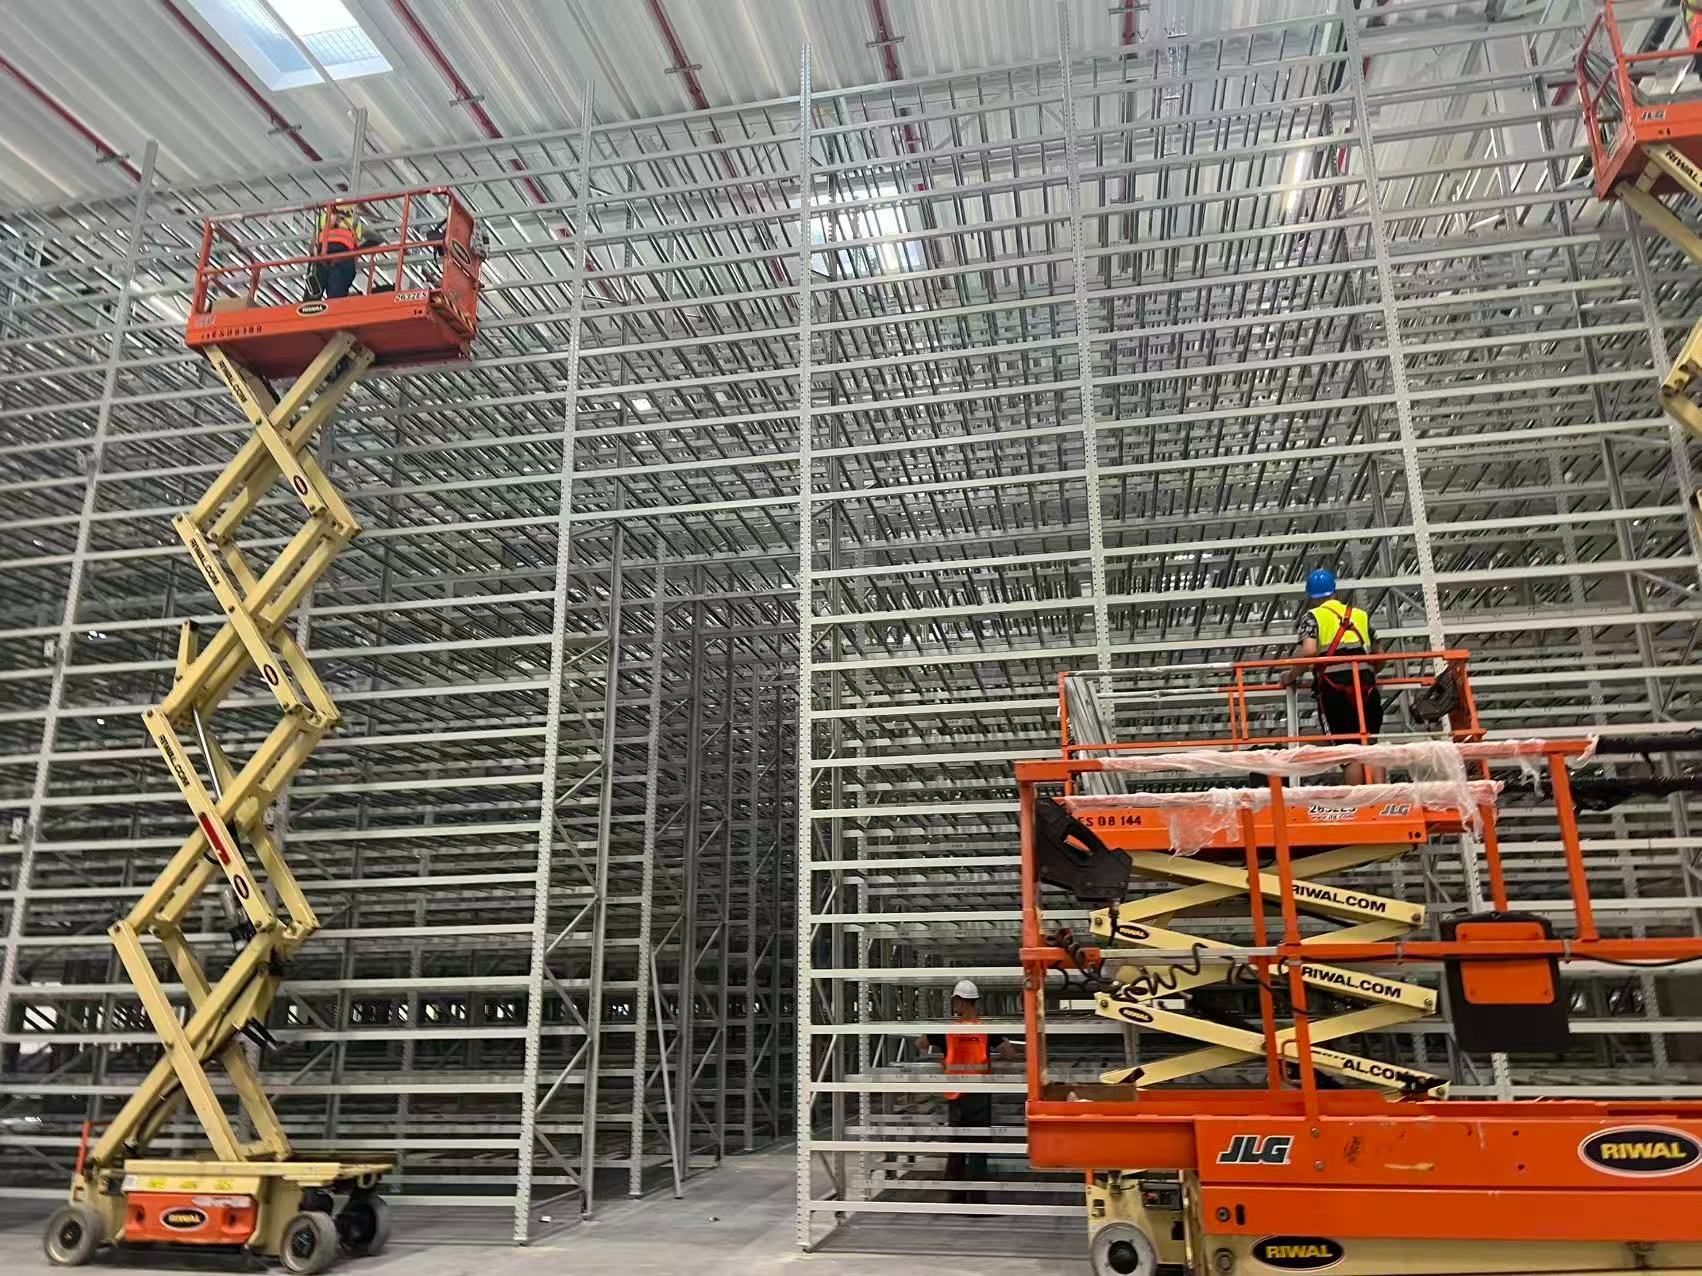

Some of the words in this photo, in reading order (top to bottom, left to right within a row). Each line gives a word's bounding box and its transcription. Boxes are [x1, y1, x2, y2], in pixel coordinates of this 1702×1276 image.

[1380, 803, 1412, 816] JLG
[1120, 815, 1142, 826] 144
[1292, 884, 1387, 913] RIWAL.COM
[1301, 966, 1402, 999] RIWAL.COM
[1216, 1135, 1294, 1164] JLG
[1600, 1142, 1687, 1159] RIWAL
[1265, 1245, 1333, 1258] RIWAL
